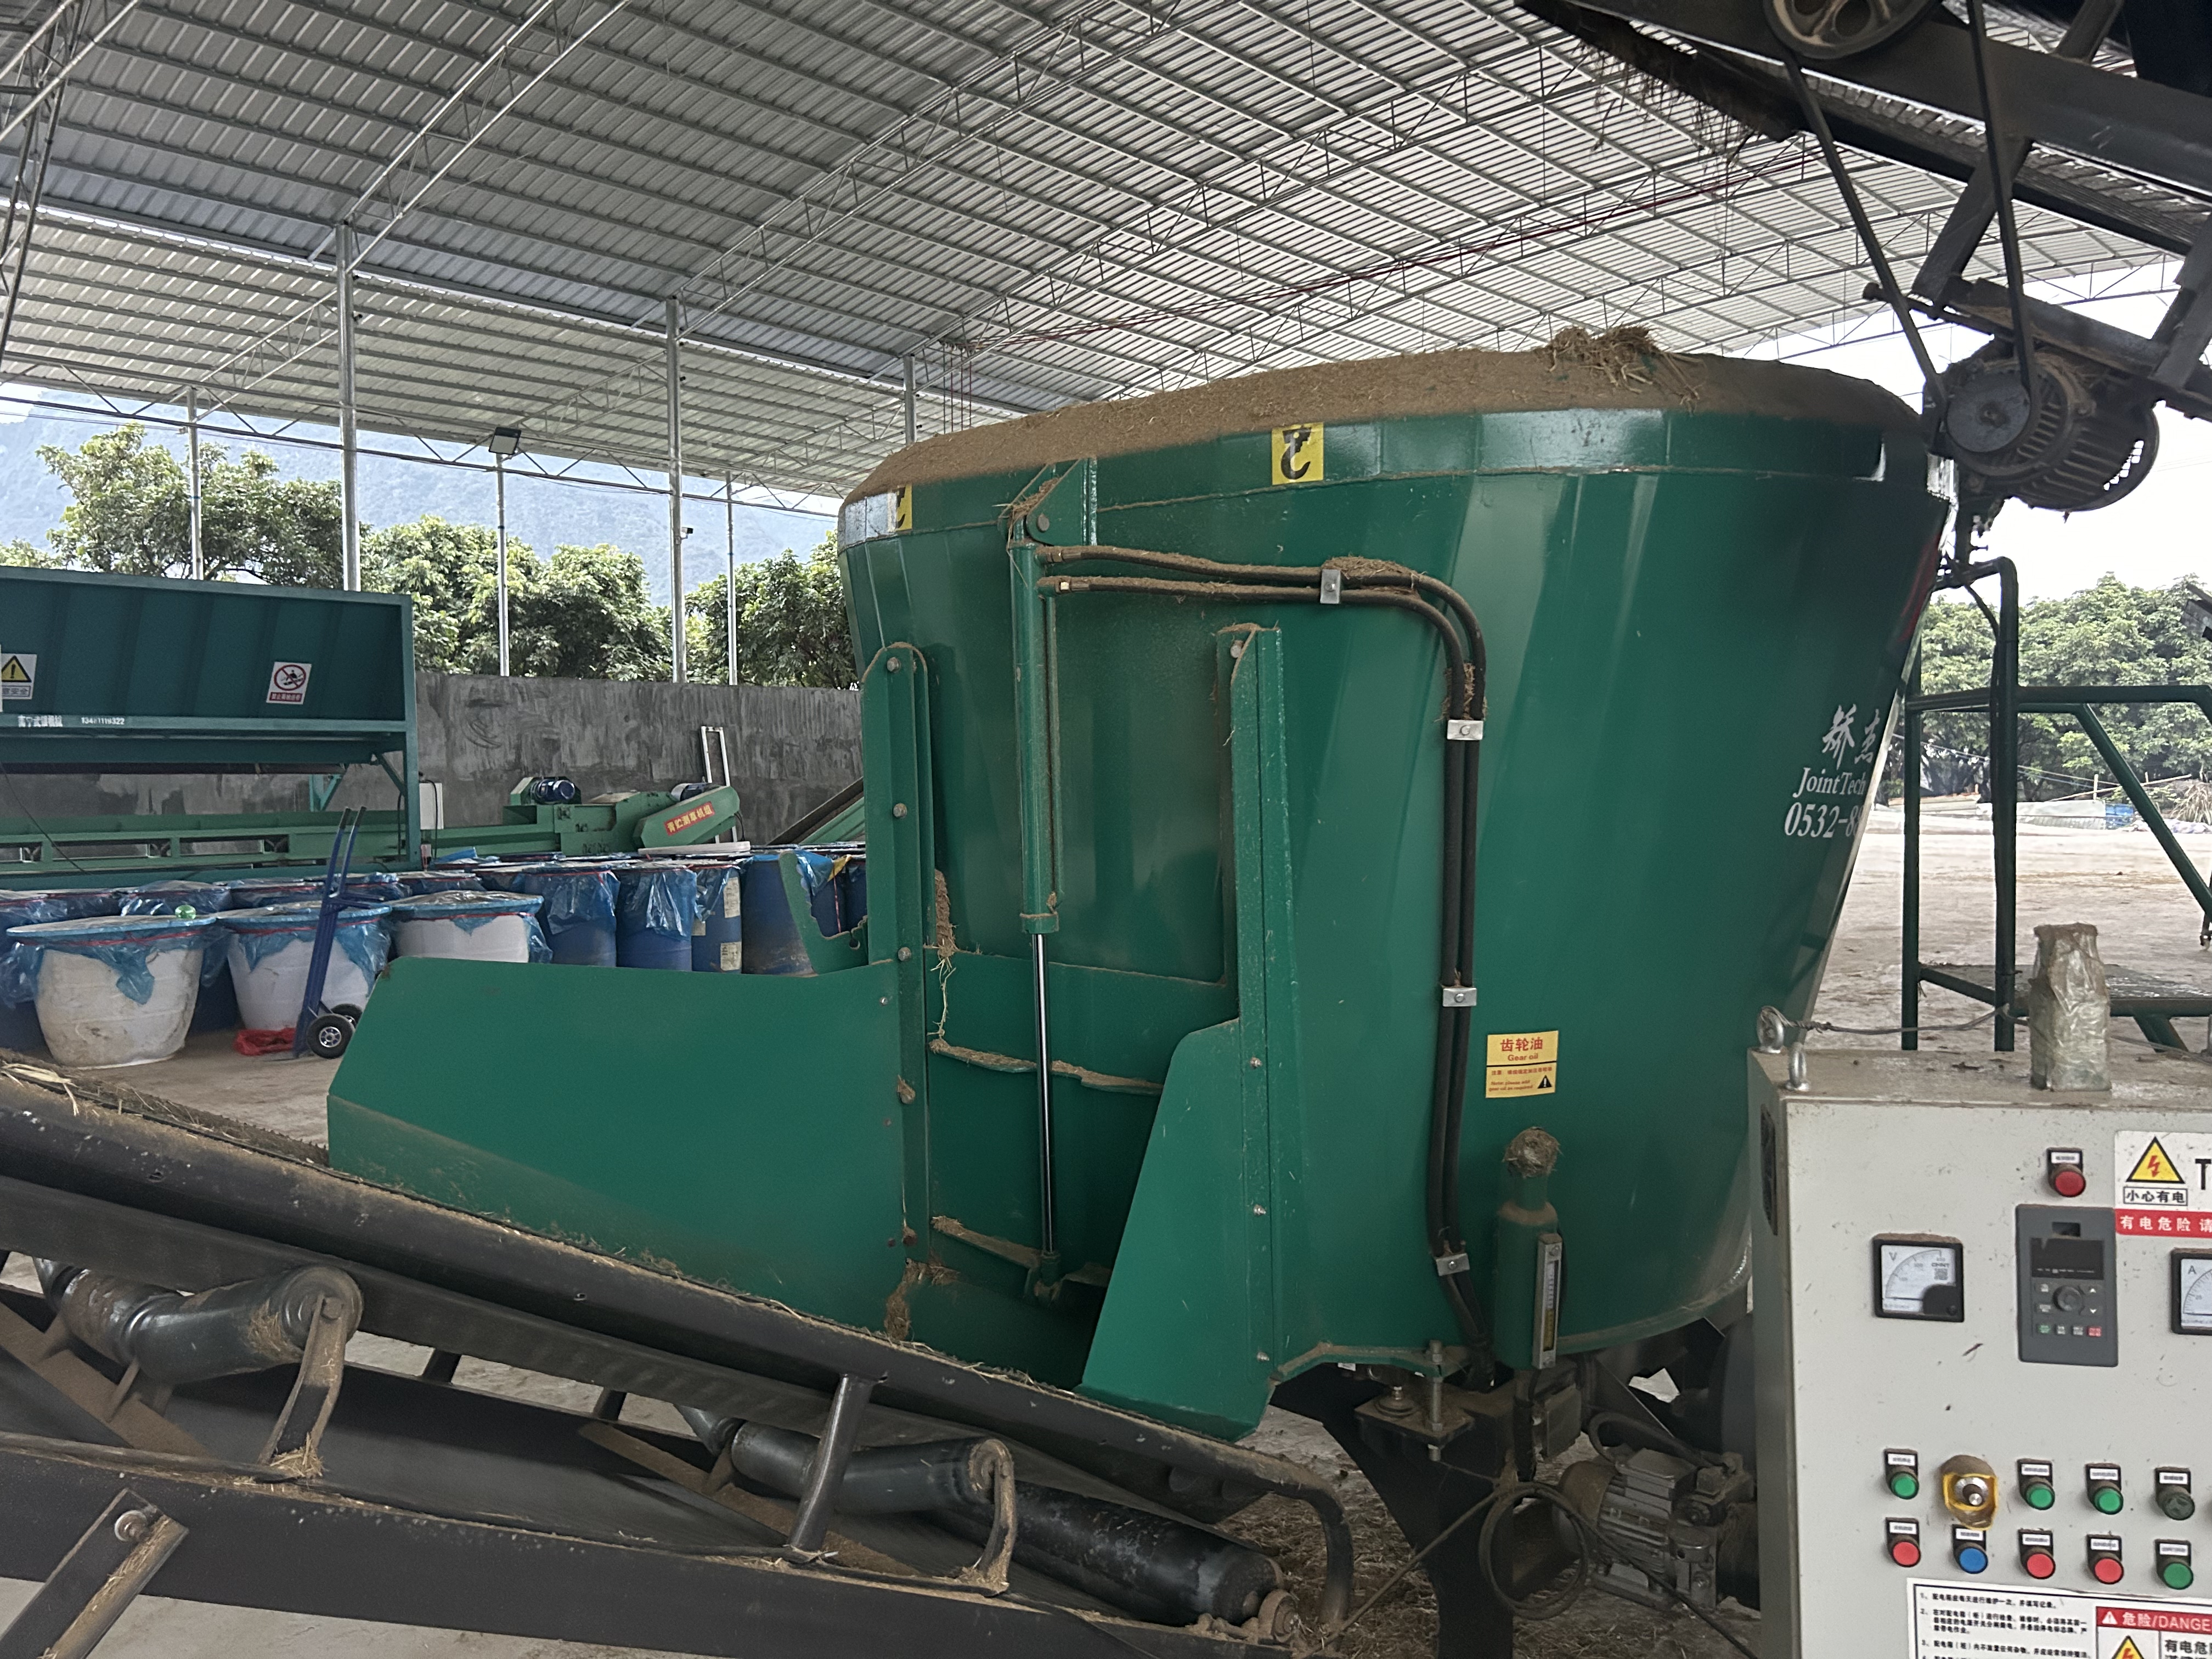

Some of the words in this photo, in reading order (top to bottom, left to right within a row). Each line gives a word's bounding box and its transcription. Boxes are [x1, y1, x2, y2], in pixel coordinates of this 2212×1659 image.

[1500, 1036, 1543, 1052] 齿轮油
[2125, 1189, 2185, 1203] 小心有电
[2119, 1215, 2191, 1232] 有电危险
[1888, 1251, 1898, 1261] V
[2187, 1265, 2197, 1274] A
